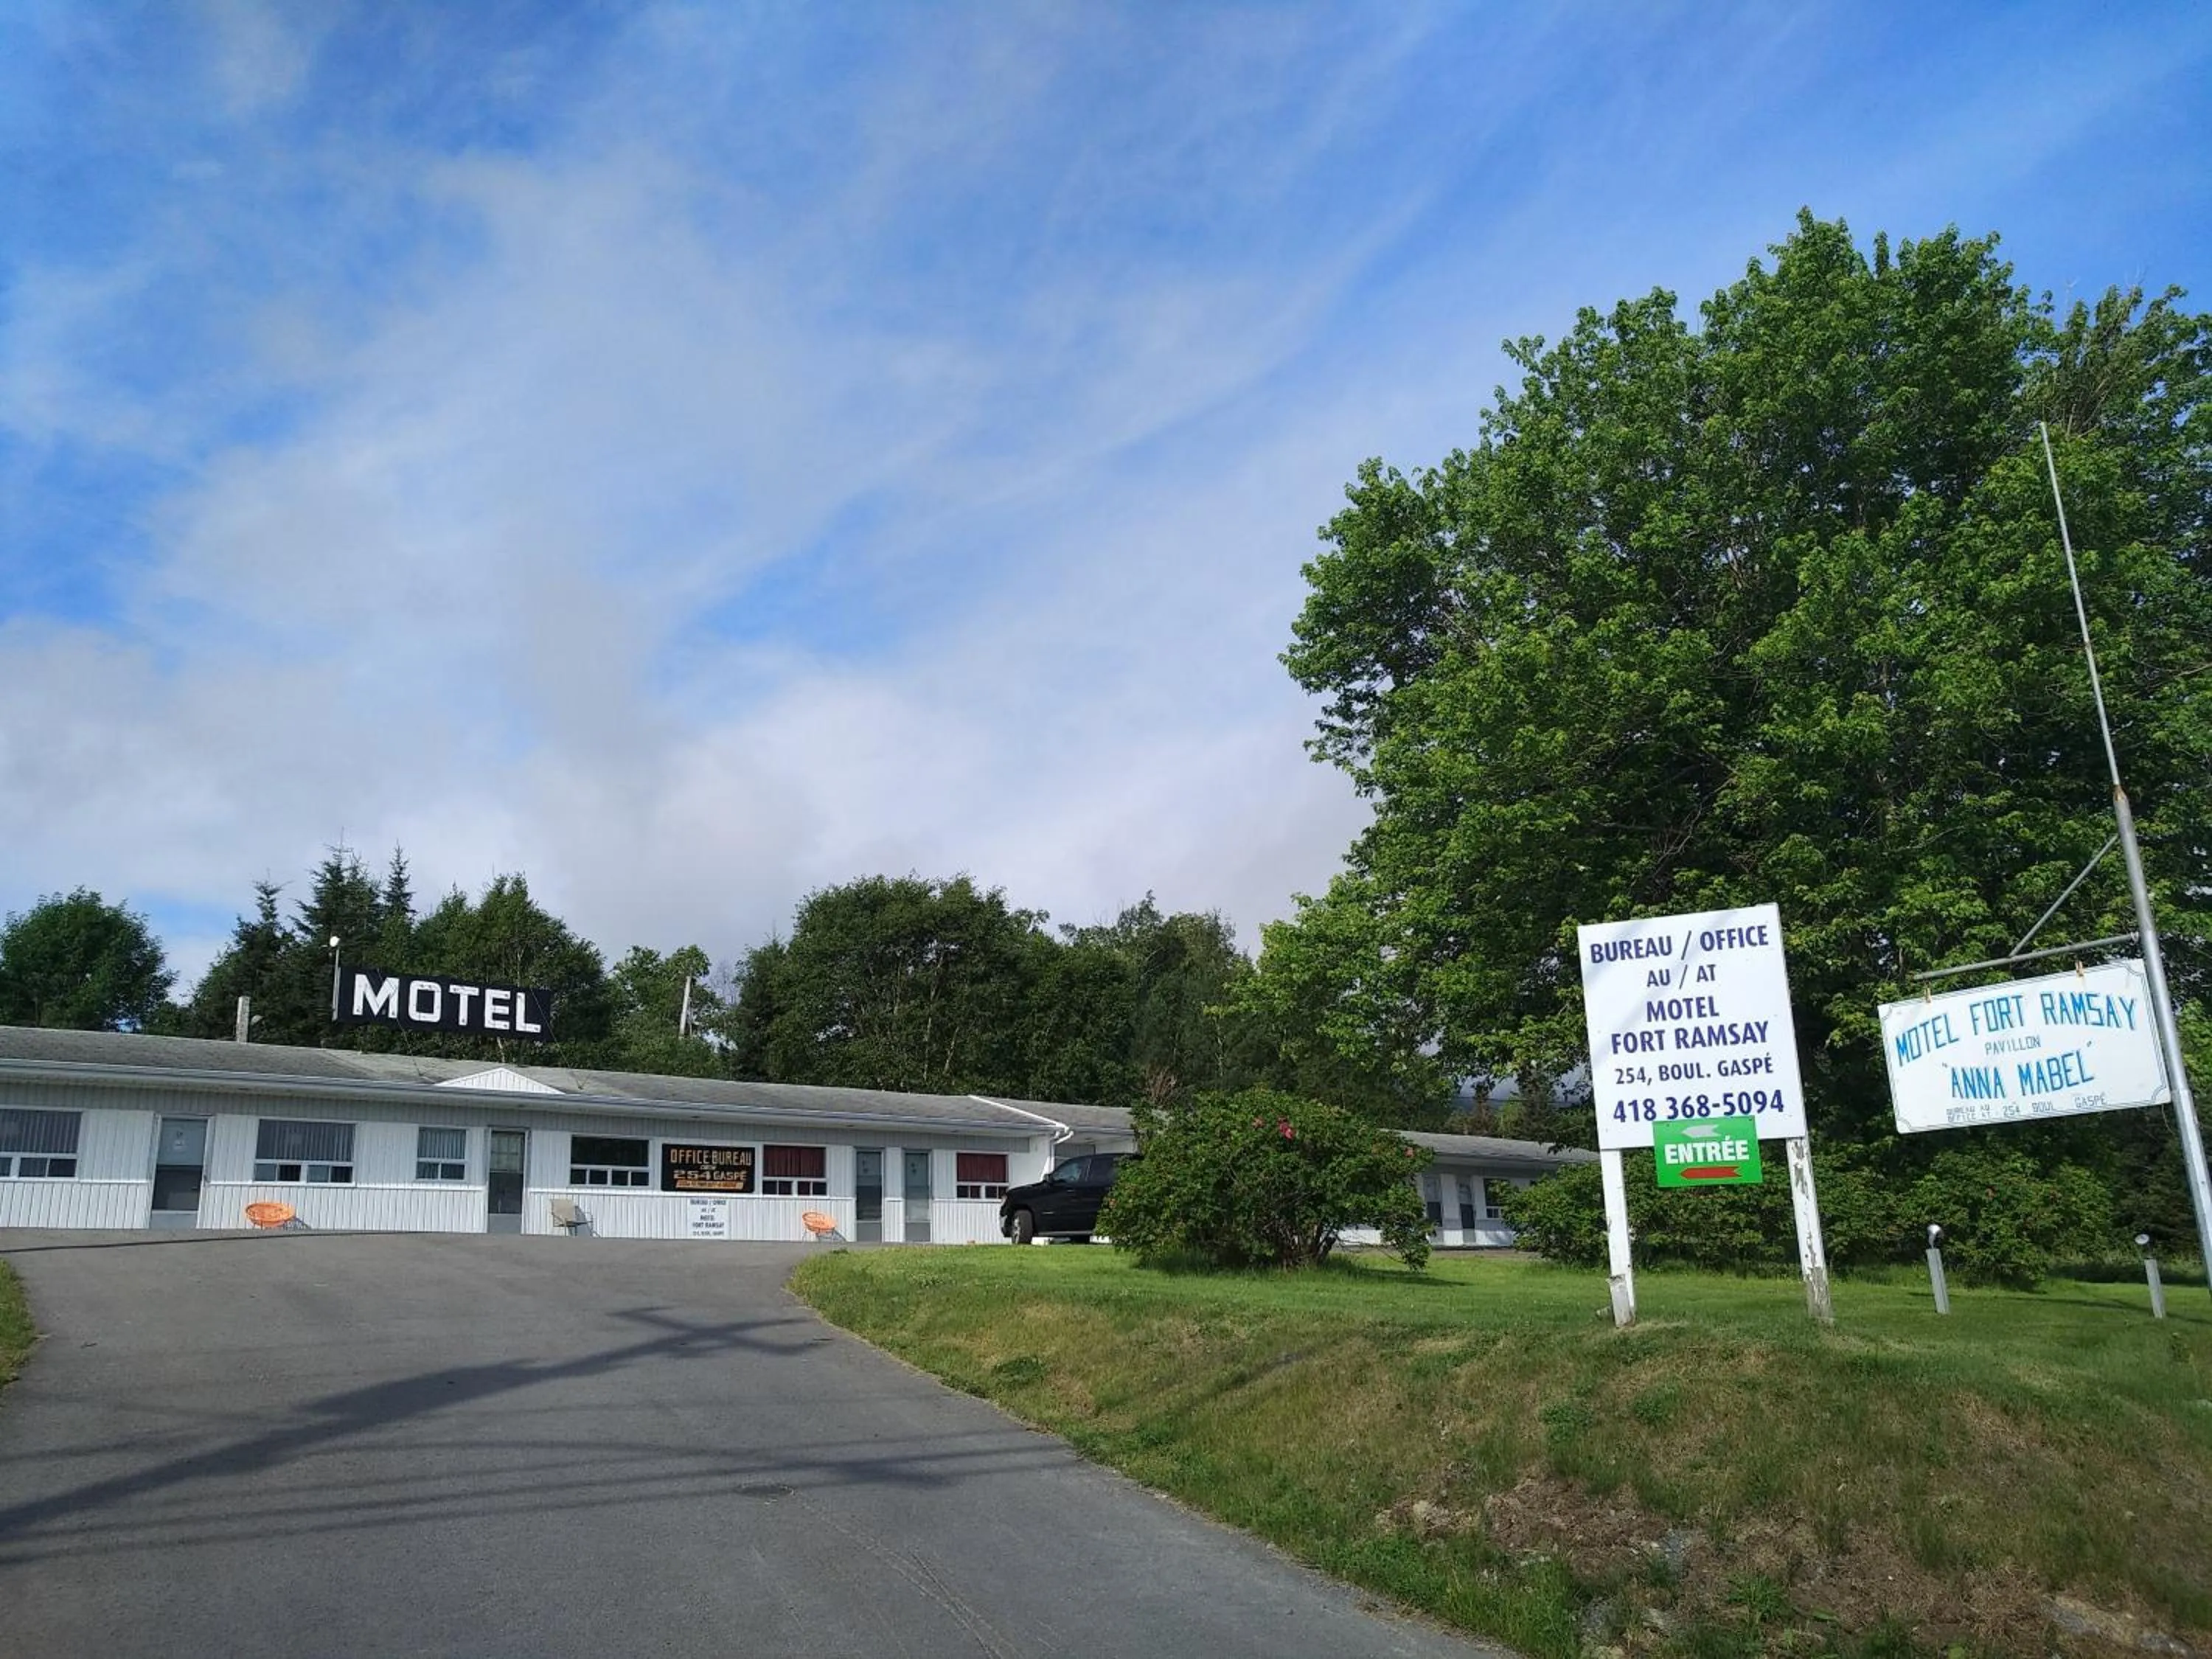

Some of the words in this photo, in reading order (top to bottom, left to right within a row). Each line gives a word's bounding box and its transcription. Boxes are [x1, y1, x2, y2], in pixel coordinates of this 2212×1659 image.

[1590, 936, 1672, 964] BUREAU
[1681, 931, 1692, 961] /
[1700, 925, 1769, 952] OFFICE
[1646, 969, 1671, 987] AU
[1679, 964, 1688, 990] /
[1696, 964, 1717, 983] AT
[352, 973, 541, 1033] MOTEL
[1646, 996, 1719, 1023] MOTEL
[1611, 1029, 1666, 1055] FORT
[1674, 1020, 1769, 1049] RAMSAY
[1895, 1014, 1959, 1067] MOTEL
[1969, 995, 2025, 1036] FORT
[2040, 992, 2136, 1031] RAMSAY
[1984, 1036, 2041, 1056] PAVILLON
[1615, 1067, 1653, 1086] 254,
[1658, 1062, 1711, 1082] BOUL.
[1717, 1052, 1774, 1077] GASPÉ
[1613, 1098, 1658, 1123] 418
[1666, 1089, 1784, 1120] 368-5094
[670, 1148, 709, 1164] OFFICE
[712, 1150, 751, 1166] BUREAU
[1664, 1135, 1750, 1165] ENTRÉE
[673, 1169, 712, 1180] 254
